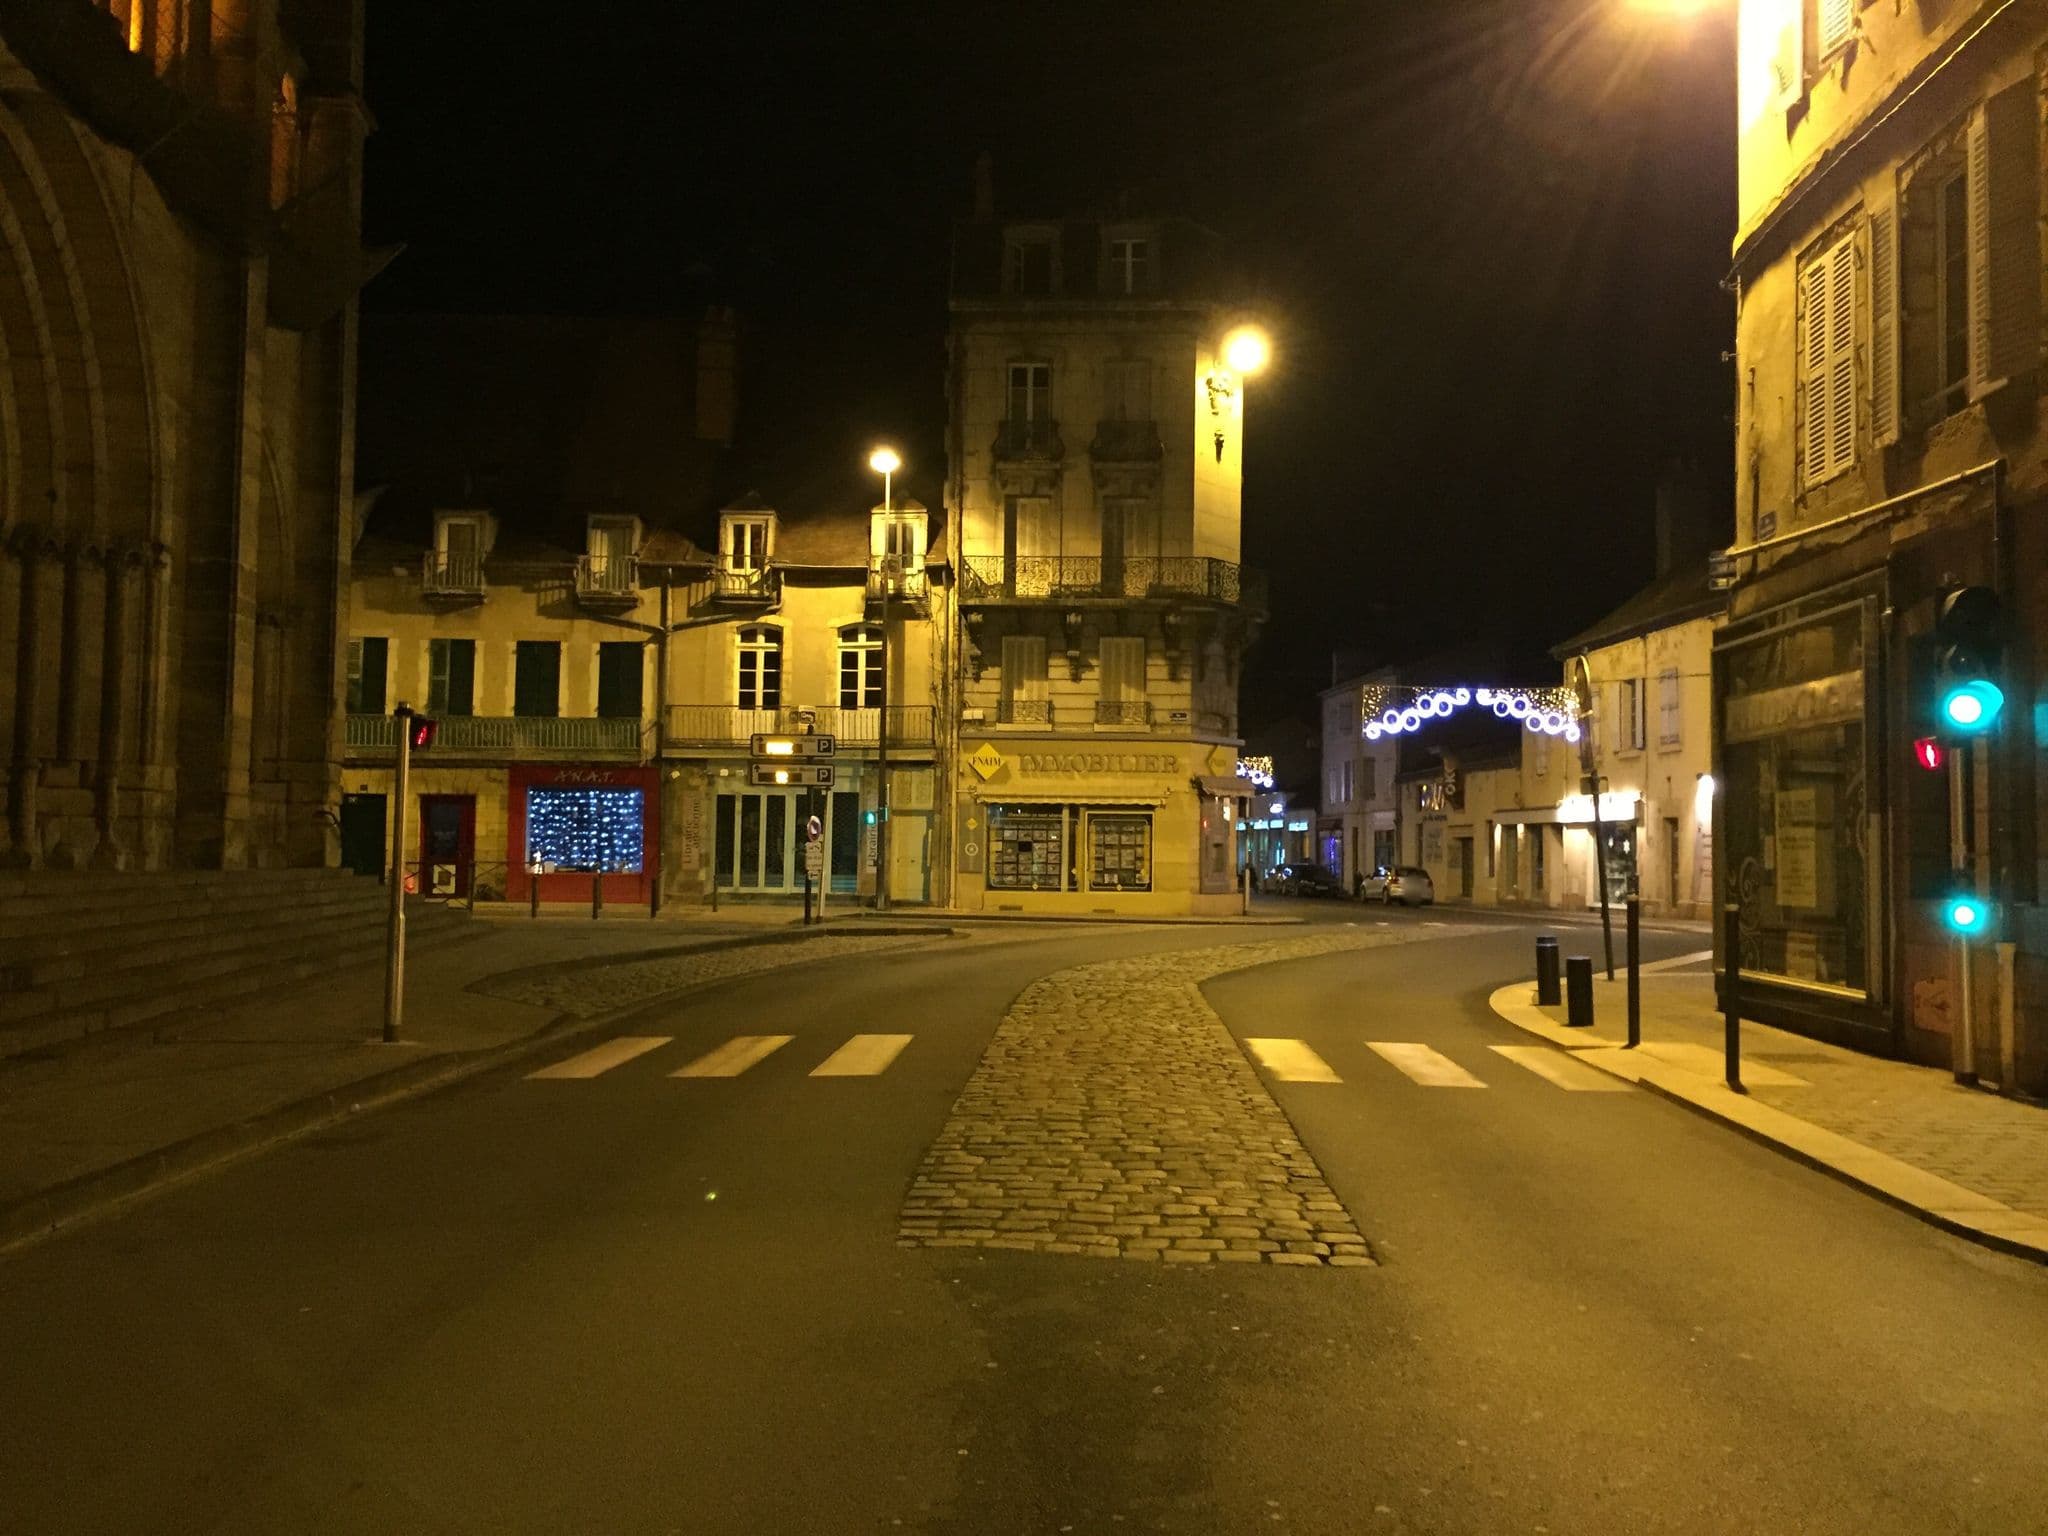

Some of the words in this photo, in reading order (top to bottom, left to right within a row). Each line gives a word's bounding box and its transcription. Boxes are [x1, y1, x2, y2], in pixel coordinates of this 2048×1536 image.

[819, 740, 829, 752] P
[972, 756, 1001, 767] FNAIM
[1017, 753, 1180, 774] IMMOBILIER
[819, 769, 829, 781] P
